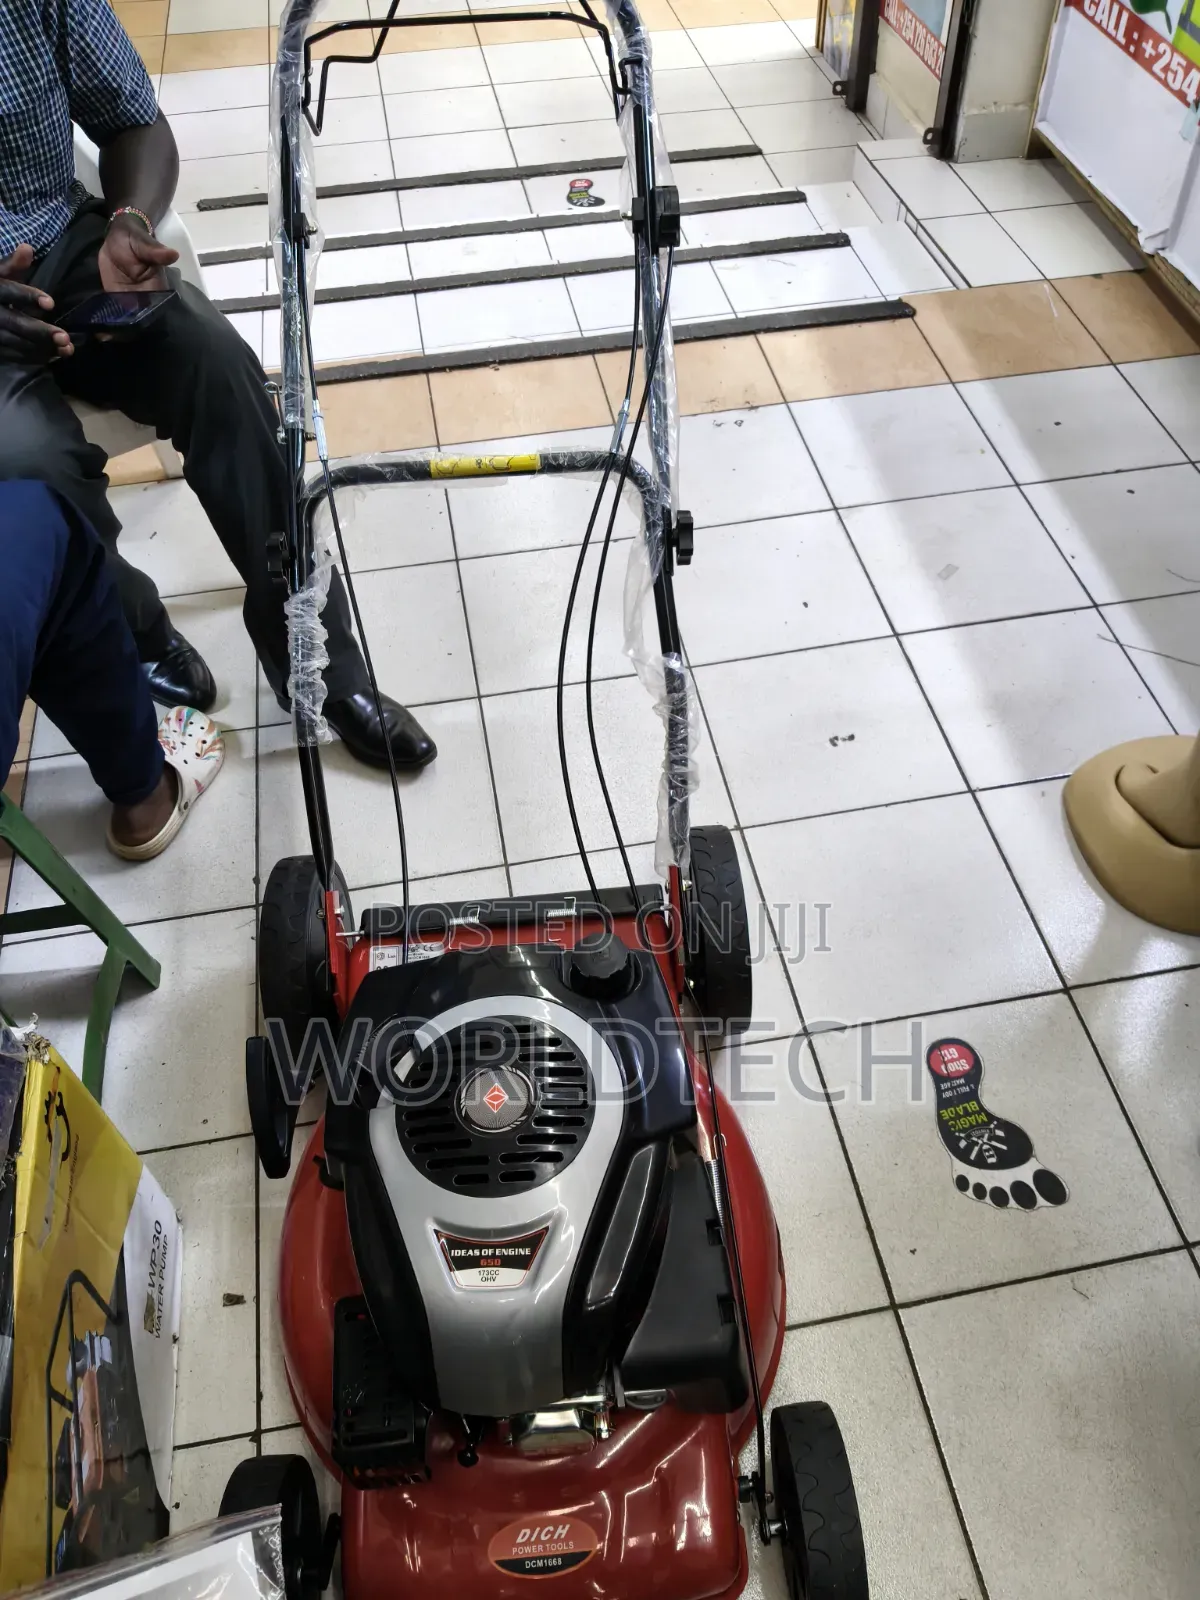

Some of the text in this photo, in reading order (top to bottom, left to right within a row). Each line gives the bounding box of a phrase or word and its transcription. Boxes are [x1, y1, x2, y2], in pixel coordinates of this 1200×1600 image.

[940, 1101, 980, 1120] BLADE
[948, 1112, 988, 1131] MAGIC
[148, 1219, 162, 1288] WP30
[451, 1249, 480, 1257] IDEAS
[481, 1248, 495, 1256] OF
[155, 1234, 169, 1339] WATER PUMP
[516, 1524, 570, 1543] DICH
[512, 1542, 574, 1555] POWER TOOLS
[525, 1558, 562, 1568] DCM1668
